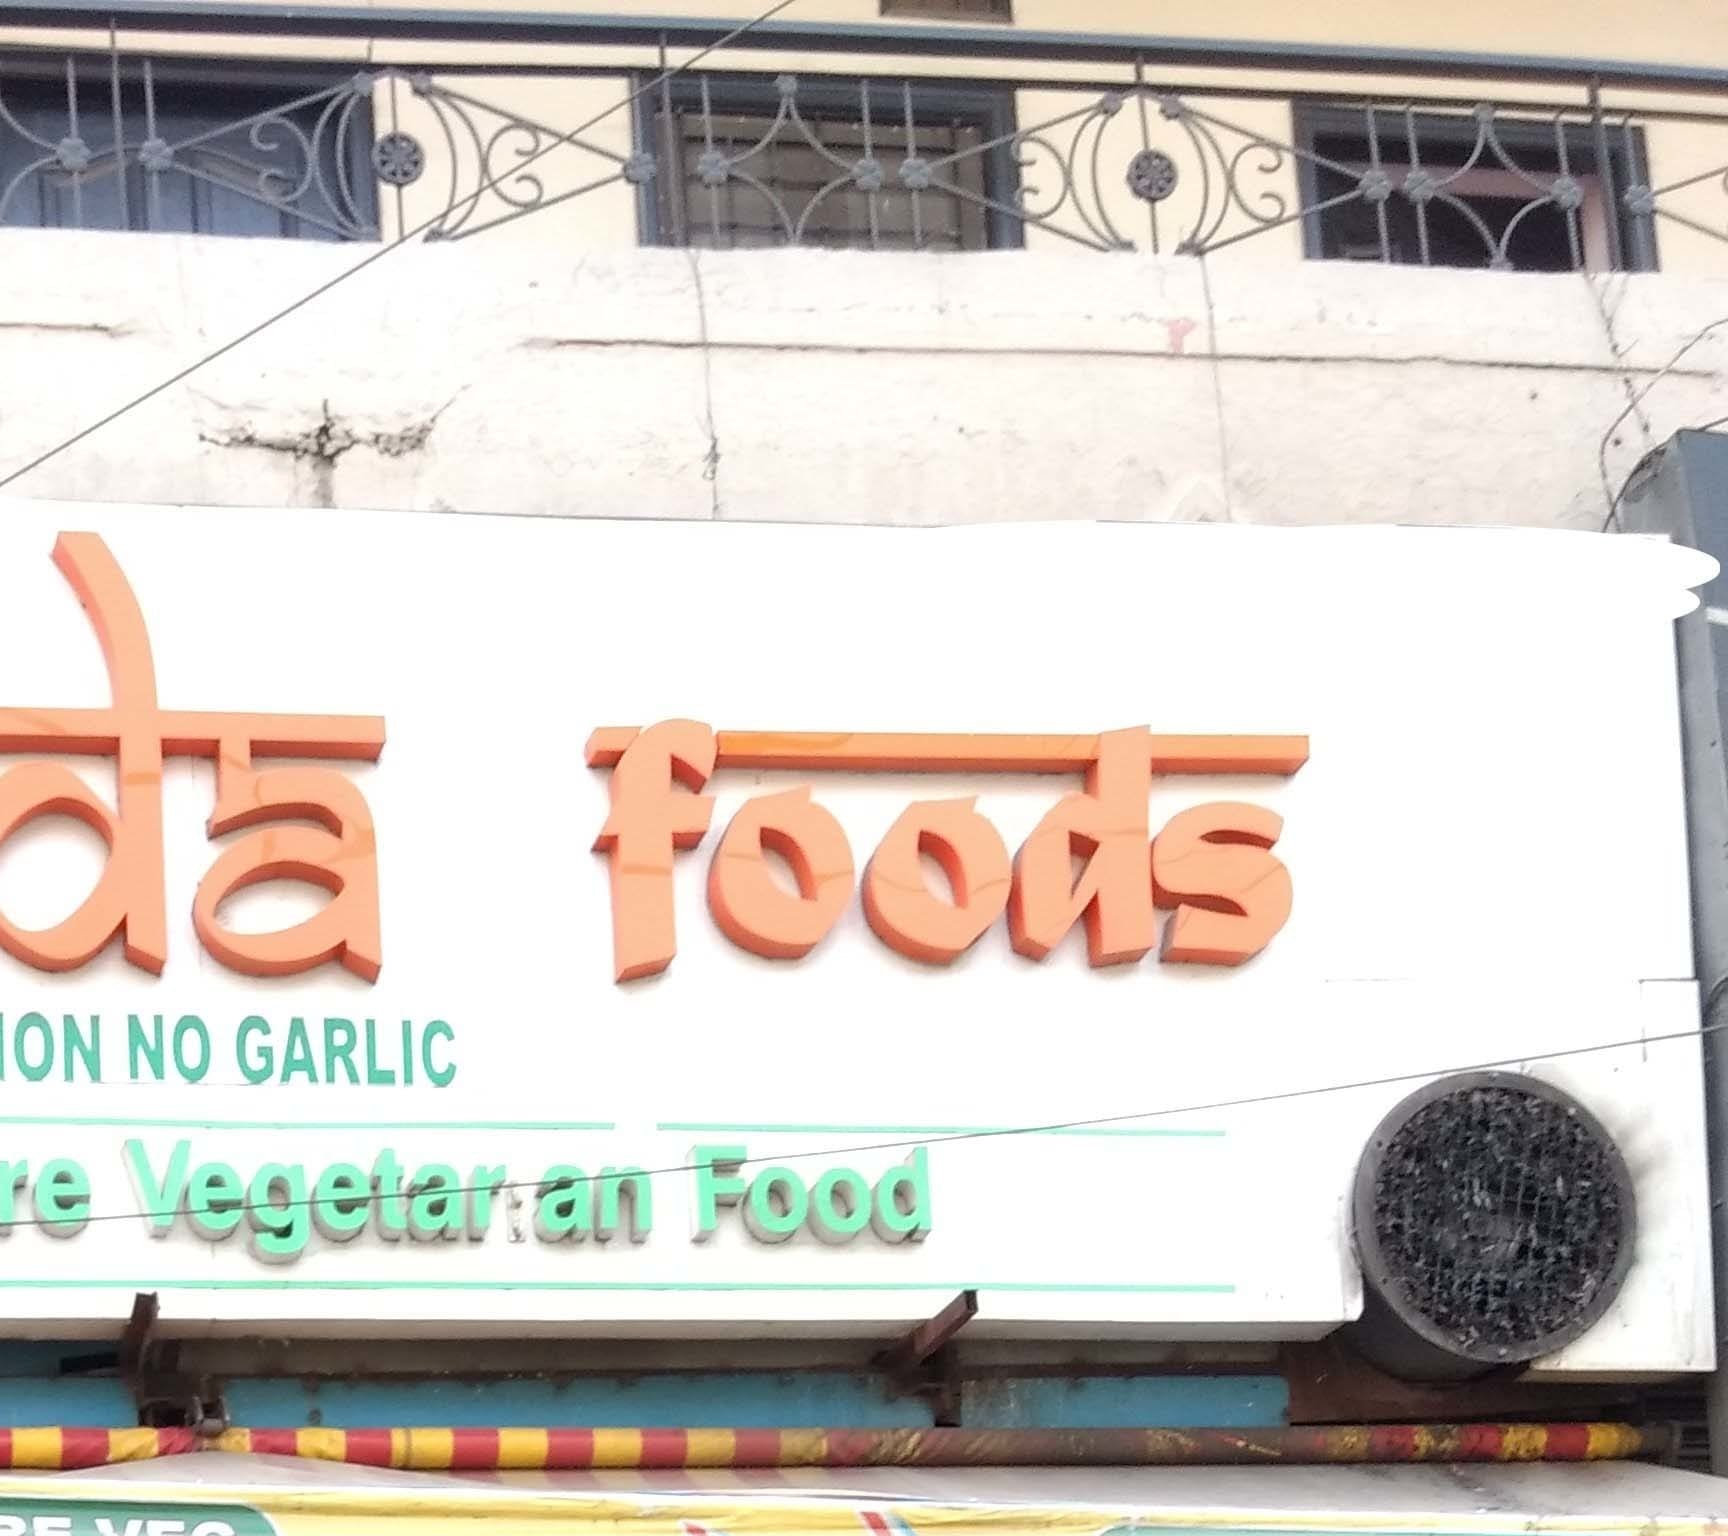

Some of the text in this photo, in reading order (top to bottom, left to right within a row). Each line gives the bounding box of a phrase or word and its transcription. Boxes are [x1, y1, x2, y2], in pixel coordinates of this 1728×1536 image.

[584, 718, 1310, 984] foods
[127, 1014, 211, 1084] NO
[235, 1016, 457, 1087] GARLIC
[124, 1138, 653, 1263] Vegetaran
[689, 1143, 933, 1243] Food
